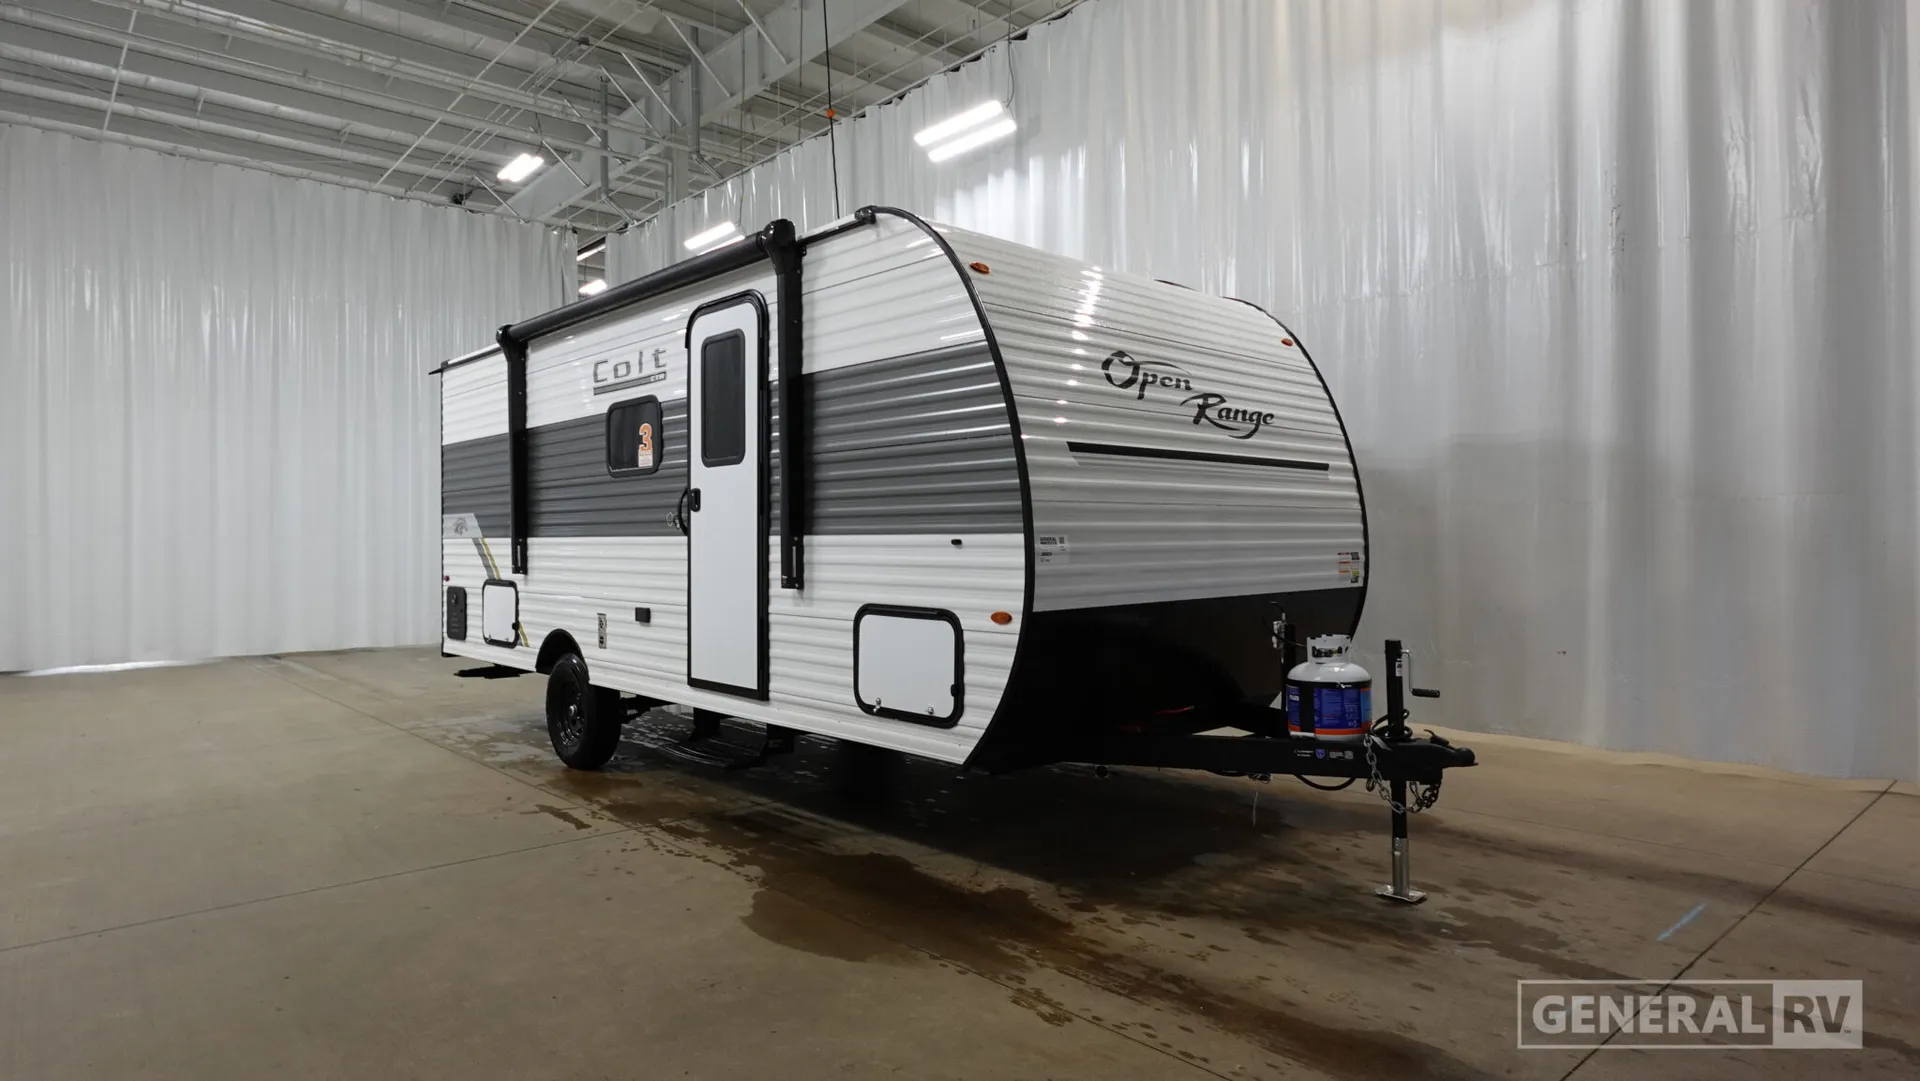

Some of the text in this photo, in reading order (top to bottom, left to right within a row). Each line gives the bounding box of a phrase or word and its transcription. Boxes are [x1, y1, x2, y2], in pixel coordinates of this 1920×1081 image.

[593, 347, 668, 384] Colt
[1101, 350, 1195, 400] Open
[639, 422, 653, 451] 3
[1179, 393, 1275, 439] Range
